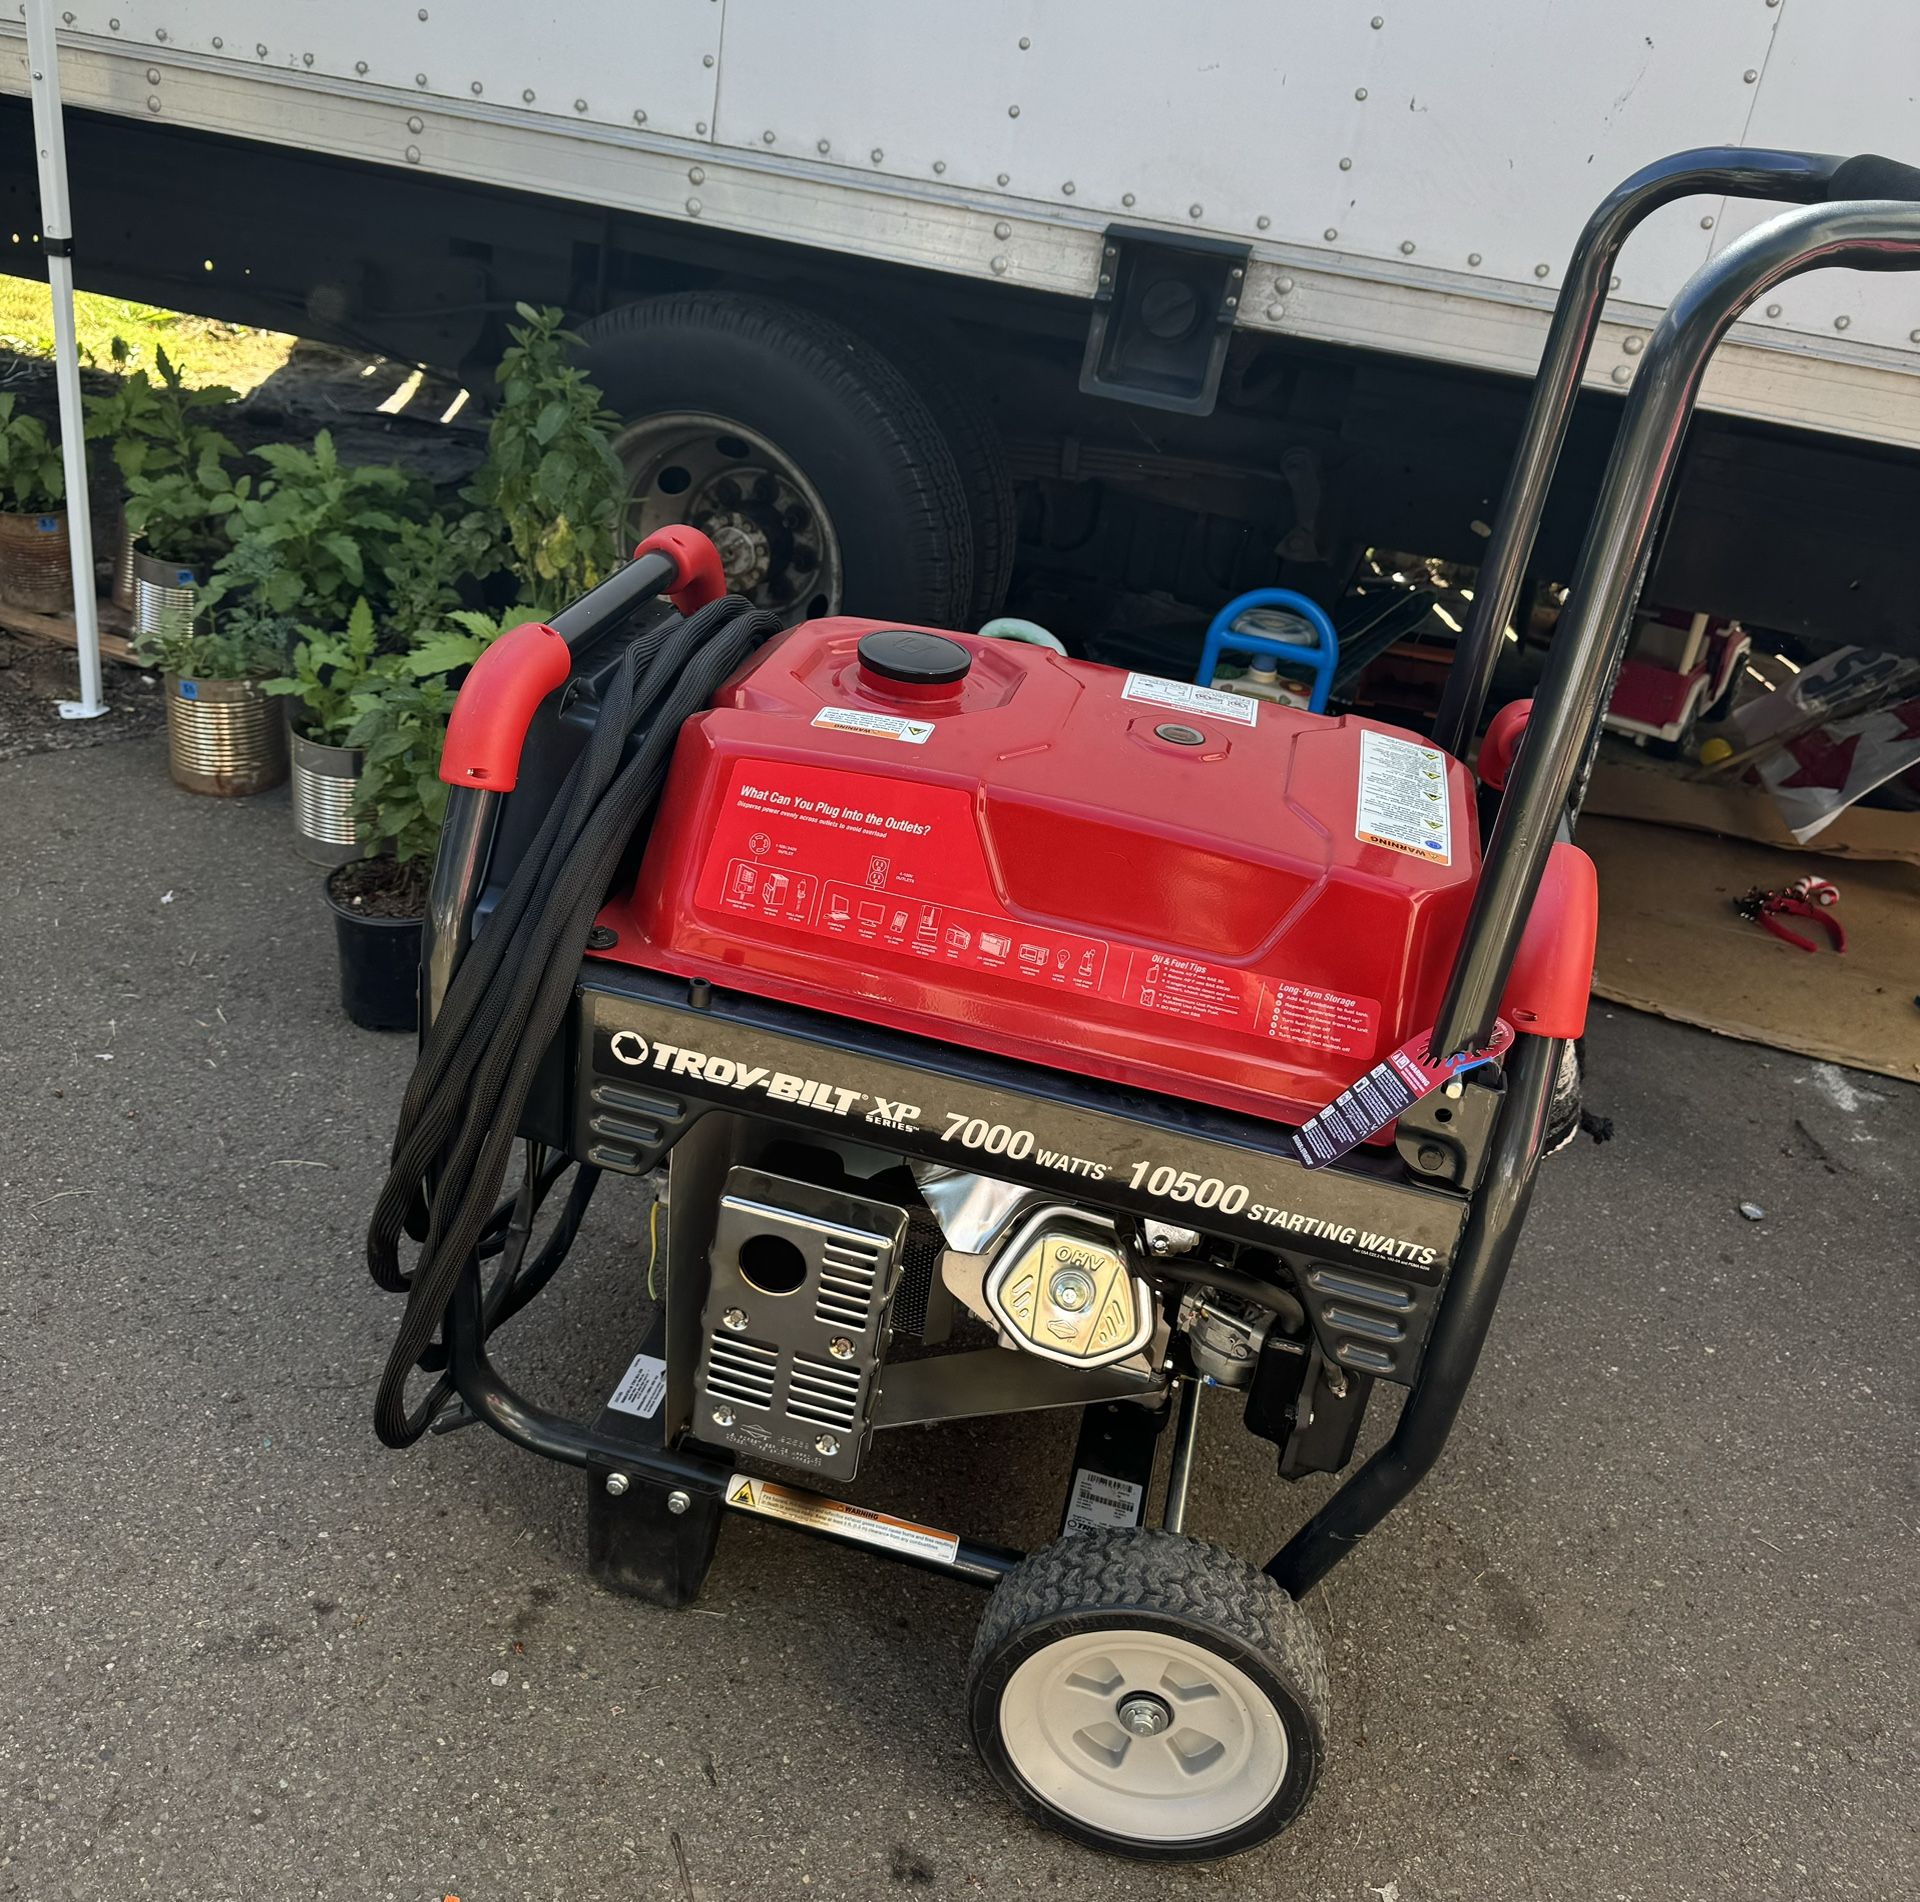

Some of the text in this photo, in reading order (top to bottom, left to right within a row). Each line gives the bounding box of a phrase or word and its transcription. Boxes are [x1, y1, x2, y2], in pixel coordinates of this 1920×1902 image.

[736, 799, 761, 811] Disperse
[761, 806, 779, 815] power
[846, 823, 862, 832] avoid
[862, 827, 887, 838] overload
[740, 785, 931, 837] What Can You Plug Into the Outlets?
[1370, 835, 1426, 857] WARNING
[1152, 954, 1163, 963] Oil
[1170, 958, 1189, 969] Fuel
[1189, 962, 1207, 974] Tips
[1279, 983, 1356, 1007] Long-Term Storage
[867, 1096, 922, 1121] XP
[940, 1112, 1035, 1161] 7000
[1129, 1160, 1250, 1215] 10500
[1248, 1204, 1357, 1244] STARTING
[1358, 1231, 1437, 1265] WATTS
[1055, 1245, 1105, 1271] OHV
[845, 1505, 879, 1521] WARNING
